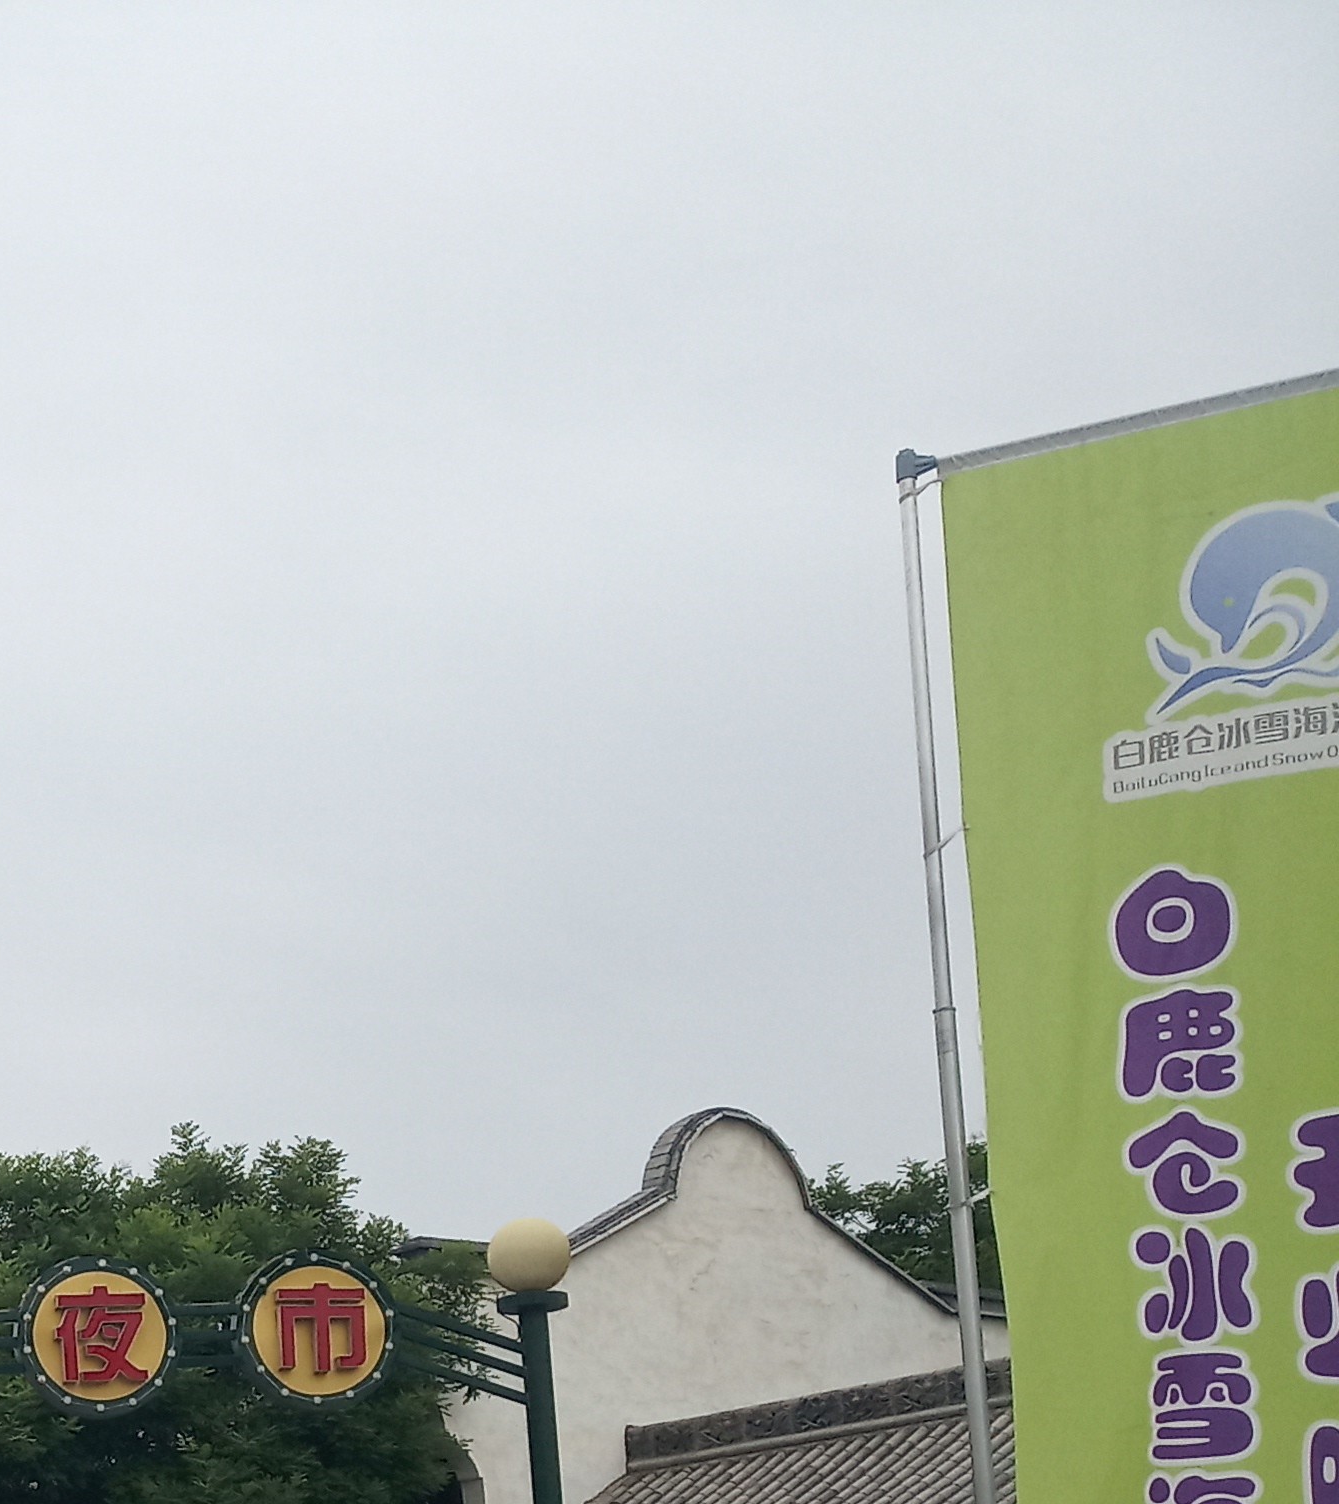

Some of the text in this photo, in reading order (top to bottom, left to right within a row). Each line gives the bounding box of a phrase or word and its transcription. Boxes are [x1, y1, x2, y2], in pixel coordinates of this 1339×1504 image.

[1112, 702, 1339, 771] 白鹿仓冰雪海
[1272, 748, 1324, 767] Snow
